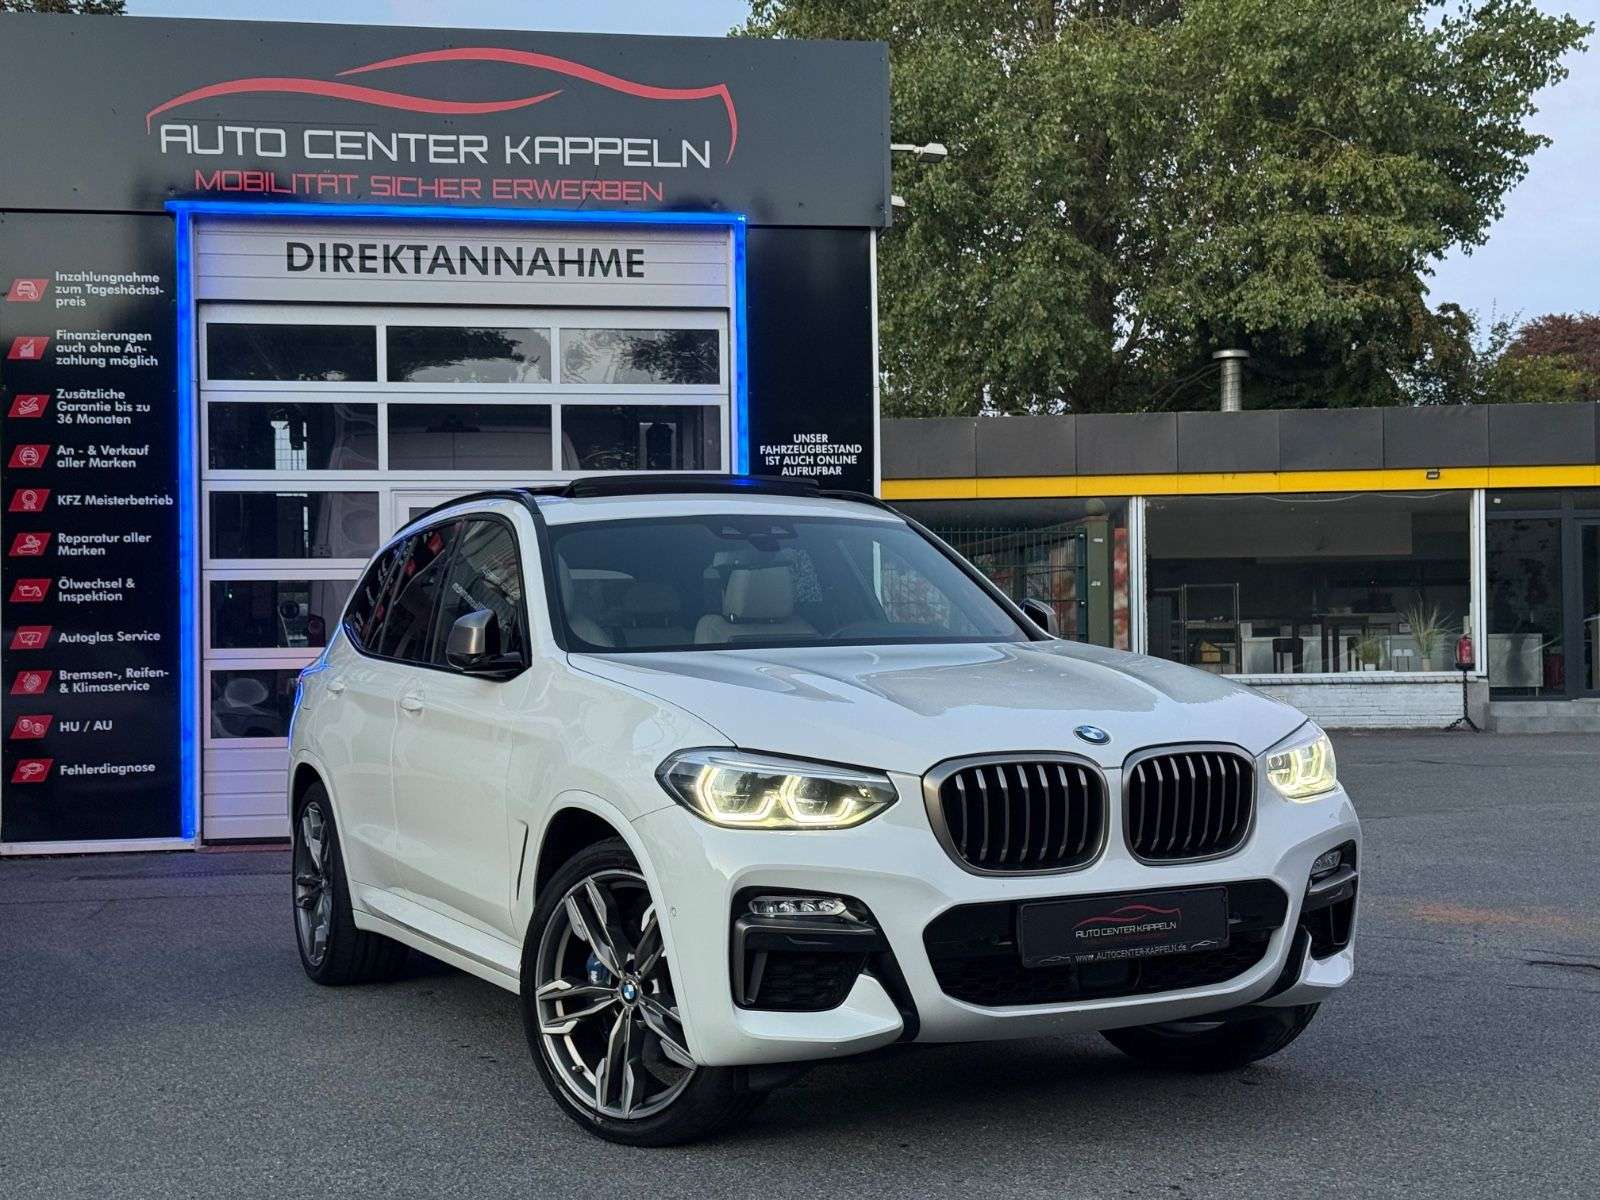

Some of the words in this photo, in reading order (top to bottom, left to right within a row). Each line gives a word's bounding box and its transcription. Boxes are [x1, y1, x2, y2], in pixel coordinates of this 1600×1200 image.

[160, 124, 287, 158] AUTO
[303, 129, 489, 164] CENTER
[504, 135, 711, 168] KAPPELN
[194, 168, 359, 194] MOBILITÄT
[370, 175, 482, 199] SICHER
[492, 178, 663, 201] ERWERBEN
[286, 241, 645, 278] DIREKTANNAHME
[55, 271, 160, 284] Inzahlungnahme
[55, 285, 82, 295] zum
[85, 284, 164, 297] Tageshöchst-
[55, 297, 88, 309] preis
[55, 330, 152, 343] Finanzierungen
[56, 342, 87, 353] auch
[90, 342, 121, 354] ohne
[124, 342, 147, 354] An-
[56, 355, 106, 368] zahlung
[109, 355, 159, 368] möglich
[56, 388, 126, 400] Zusätzliche
[57, 400, 112, 412] Garantie
[115, 400, 133, 412] bis
[136, 403, 151, 413] zu
[57, 413, 73, 425] 36
[76, 413, 132, 425] Monaten
[793, 433, 829, 444] UNSER
[57, 445, 75, 456] An
[87, 444, 97, 456] &
[100, 444, 150, 456] Verkauf
[760, 444, 863, 455] FAHRZEUGBESTAND
[57, 457, 87, 469] aller
[89, 457, 137, 469] Marken
[765, 455, 781, 466] IST
[783, 455, 814, 466] AUCH
[816, 455, 858, 465] ONLINE
[781, 466, 842, 476] AUFRUFBAR
[57, 495, 81, 506] KFZ
[84, 495, 174, 506] Meisterbetrieb
[57, 533, 120, 546] Reparatur
[122, 532, 152, 543] aller
[57, 545, 106, 556] Marken
[58, 576, 122, 589] Ölwechsel
[125, 578, 136, 589] &
[58, 590, 123, 604] Inspektion
[58, 632, 114, 645] Autoglas
[116, 631, 161, 642] Service
[59, 669, 122, 681] Bremsen-,
[125, 667, 170, 680] Reifen-
[59, 682, 69, 694] &
[72, 681, 151, 693] Klimaservice
[59, 721, 80, 732] HU
[83, 720, 90, 732] /
[92, 720, 113, 731] AU
[59, 762, 156, 776] Fehlerdiagnose
[1075, 928, 1101, 938] AUTO
[1101, 925, 1136, 936] CENTER
[1136, 922, 1177, 932] KAPPELN
